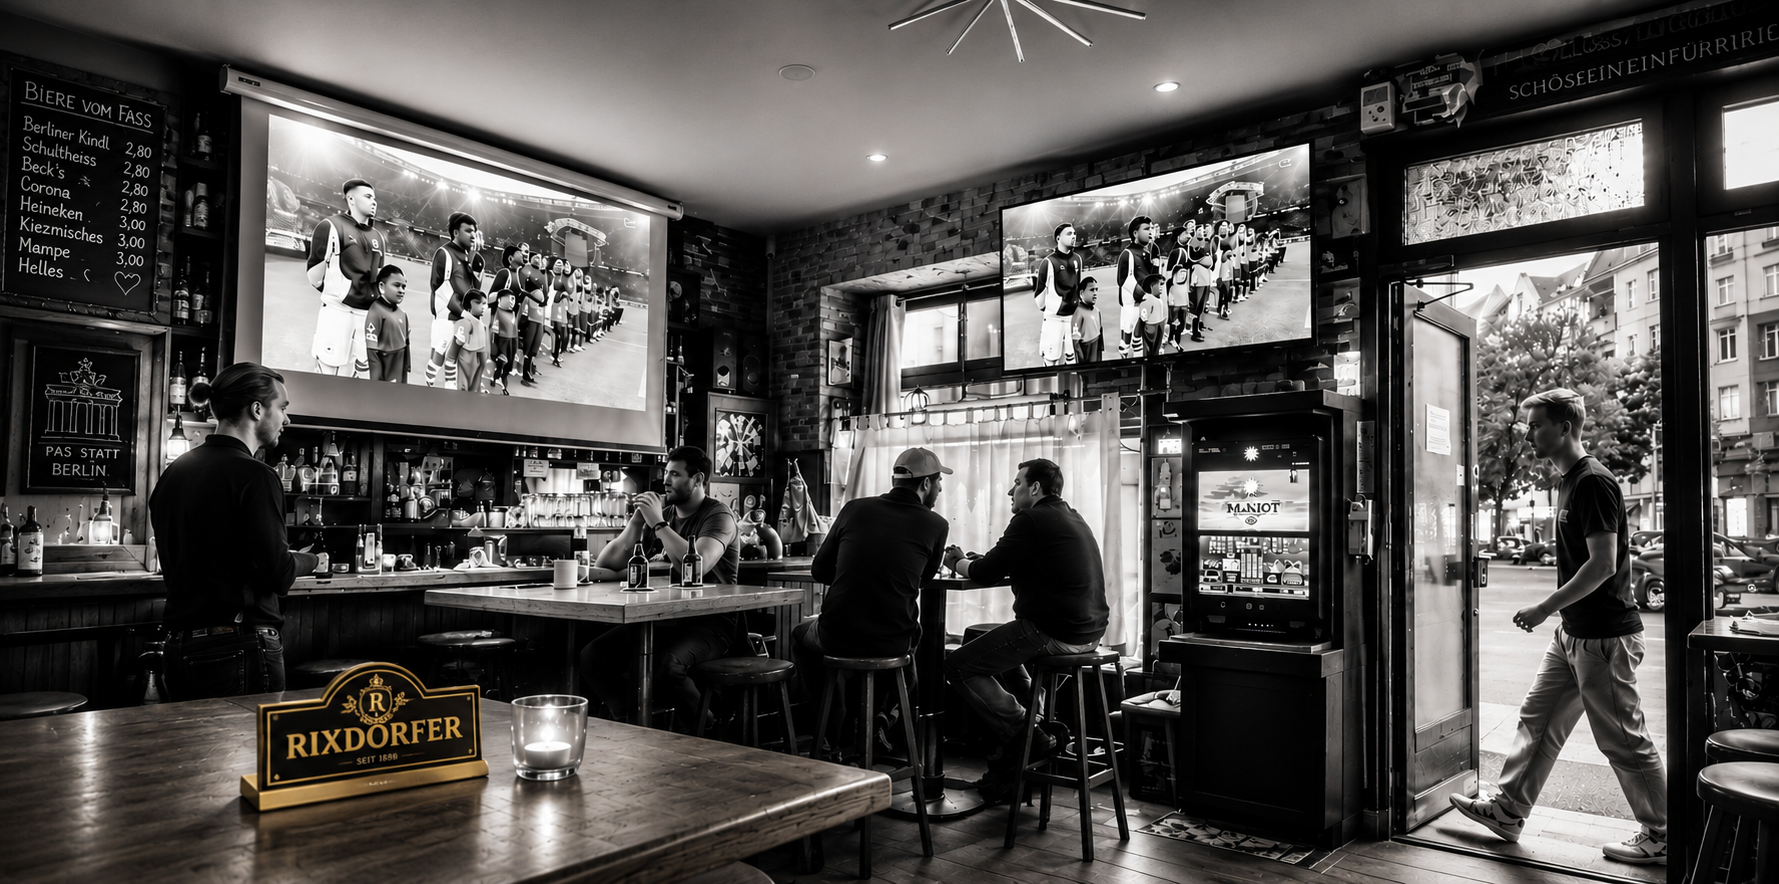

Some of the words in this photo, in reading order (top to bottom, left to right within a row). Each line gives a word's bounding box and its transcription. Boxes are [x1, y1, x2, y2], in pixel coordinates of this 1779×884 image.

[118, 104, 152, 129] FASS
[22, 115, 75, 141] Berliner
[78, 129, 110, 151] Kindl
[125, 141, 152, 159] 2,80
[22, 136, 97, 167] Schultheiss
[123, 161, 150, 179] 2,80
[21, 156, 65, 179] Beck's
[121, 180, 149, 197] 2,80
[20, 175, 71, 200] Corona
[119, 198, 148, 215] 2,80
[20, 195, 83, 222] Heineken
[118, 215, 146, 231] 3,00
[19, 216, 104, 245] Kiezmisches
[117, 233, 146, 250] 3,00
[18, 236, 71, 260] Mampe
[115, 251, 145, 267] 3,00
[18, 256, 64, 279] Helles
[46, 446, 72, 458] PAS
[80, 447, 121, 460] STATT
[369, 692, 386, 713] R
[286, 715, 464, 760] RIXDORFER
[356, 755, 377, 766] SEIT
